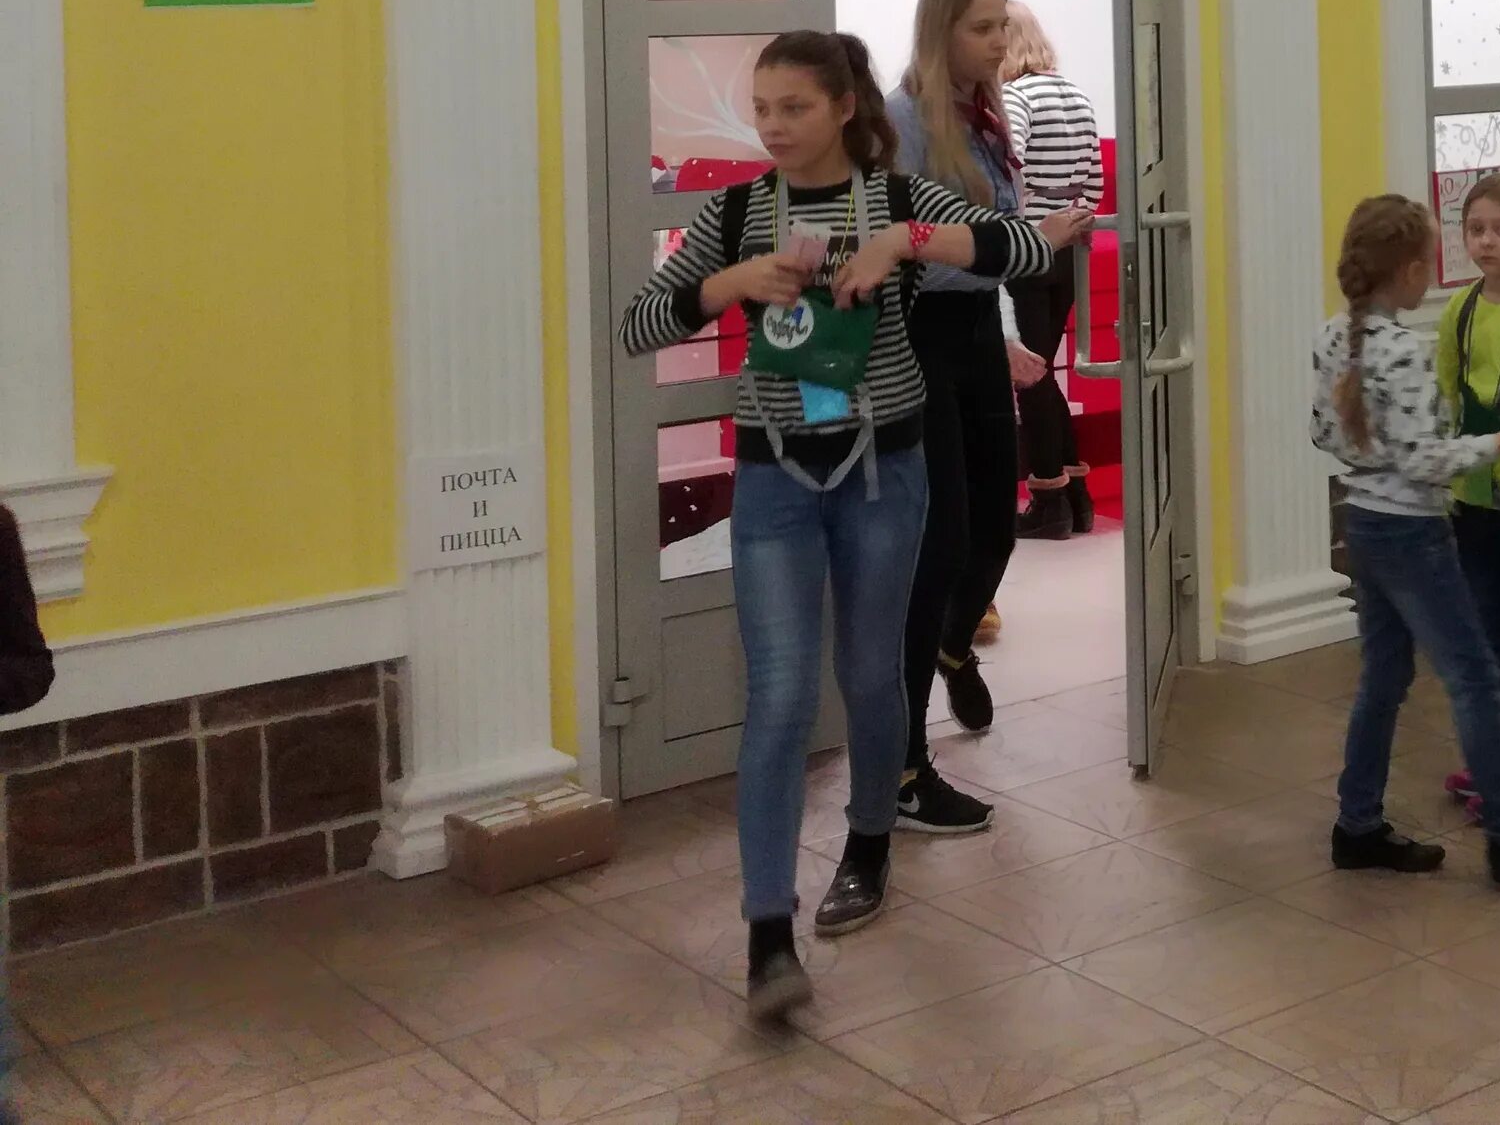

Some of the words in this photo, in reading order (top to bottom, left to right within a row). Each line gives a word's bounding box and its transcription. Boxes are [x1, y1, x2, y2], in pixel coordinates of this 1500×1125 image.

[440, 466, 518, 493] ПОЧТА
[472, 499, 489, 518] И
[439, 525, 523, 553] ПИЦЦА
